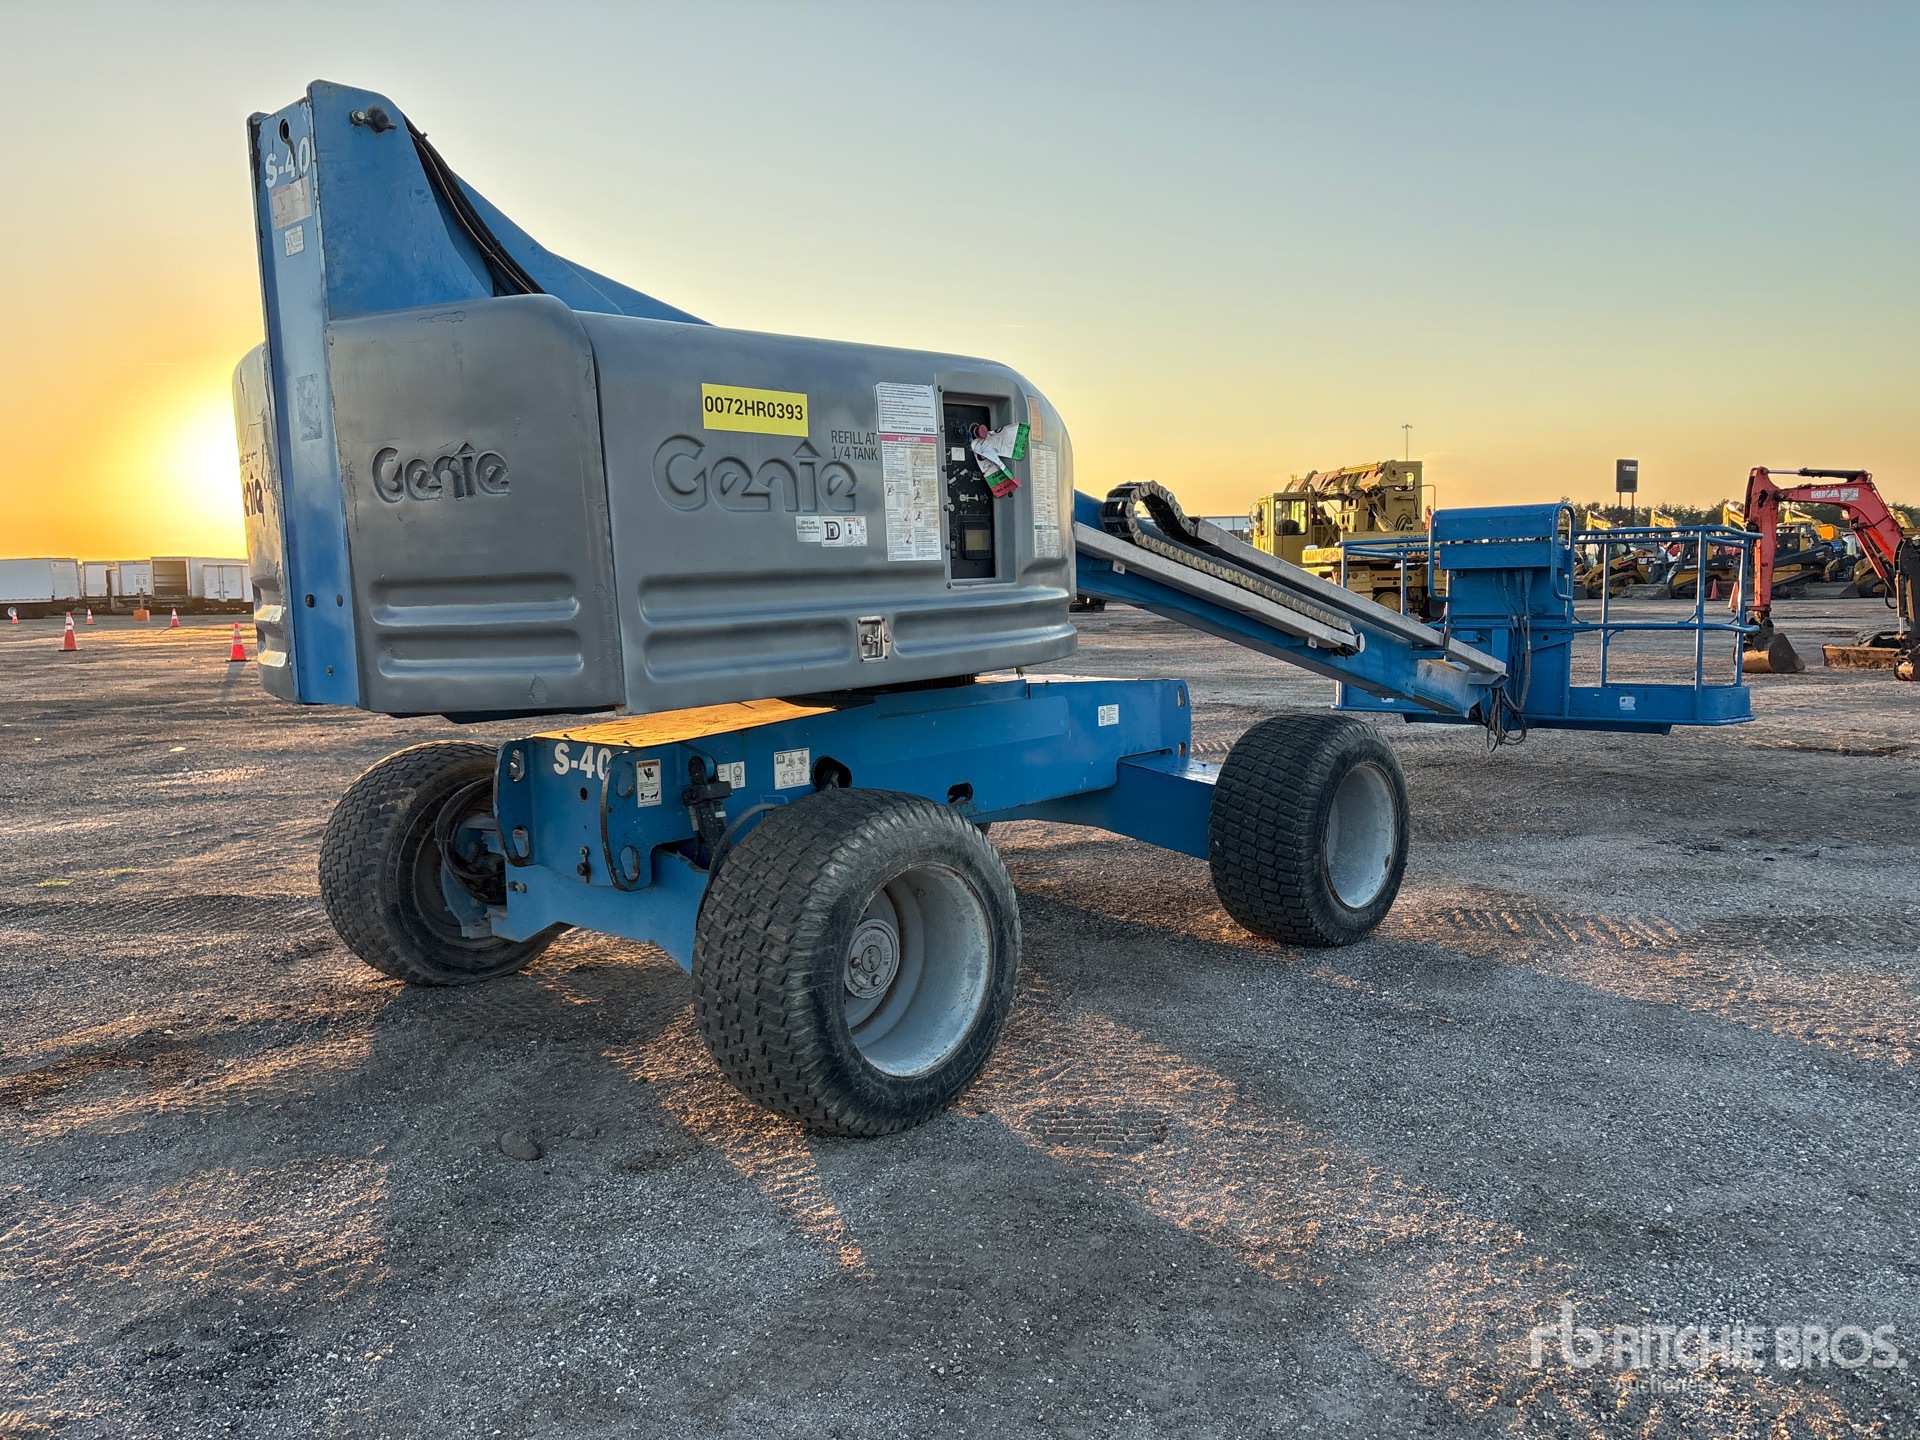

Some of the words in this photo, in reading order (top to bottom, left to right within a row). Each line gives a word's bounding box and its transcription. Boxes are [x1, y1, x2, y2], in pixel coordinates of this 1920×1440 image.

[265, 137, 310, 189] S-40
[704, 395, 803, 421] 0072HR0393
[831, 430, 863, 445] REFILL
[865, 432, 876, 445] AT
[832, 446, 851, 462] 1/4
[852, 447, 878, 461] TANK
[371, 441, 511, 504] Genie
[652, 433, 858, 512] Genie
[553, 742, 612, 781] S-40
